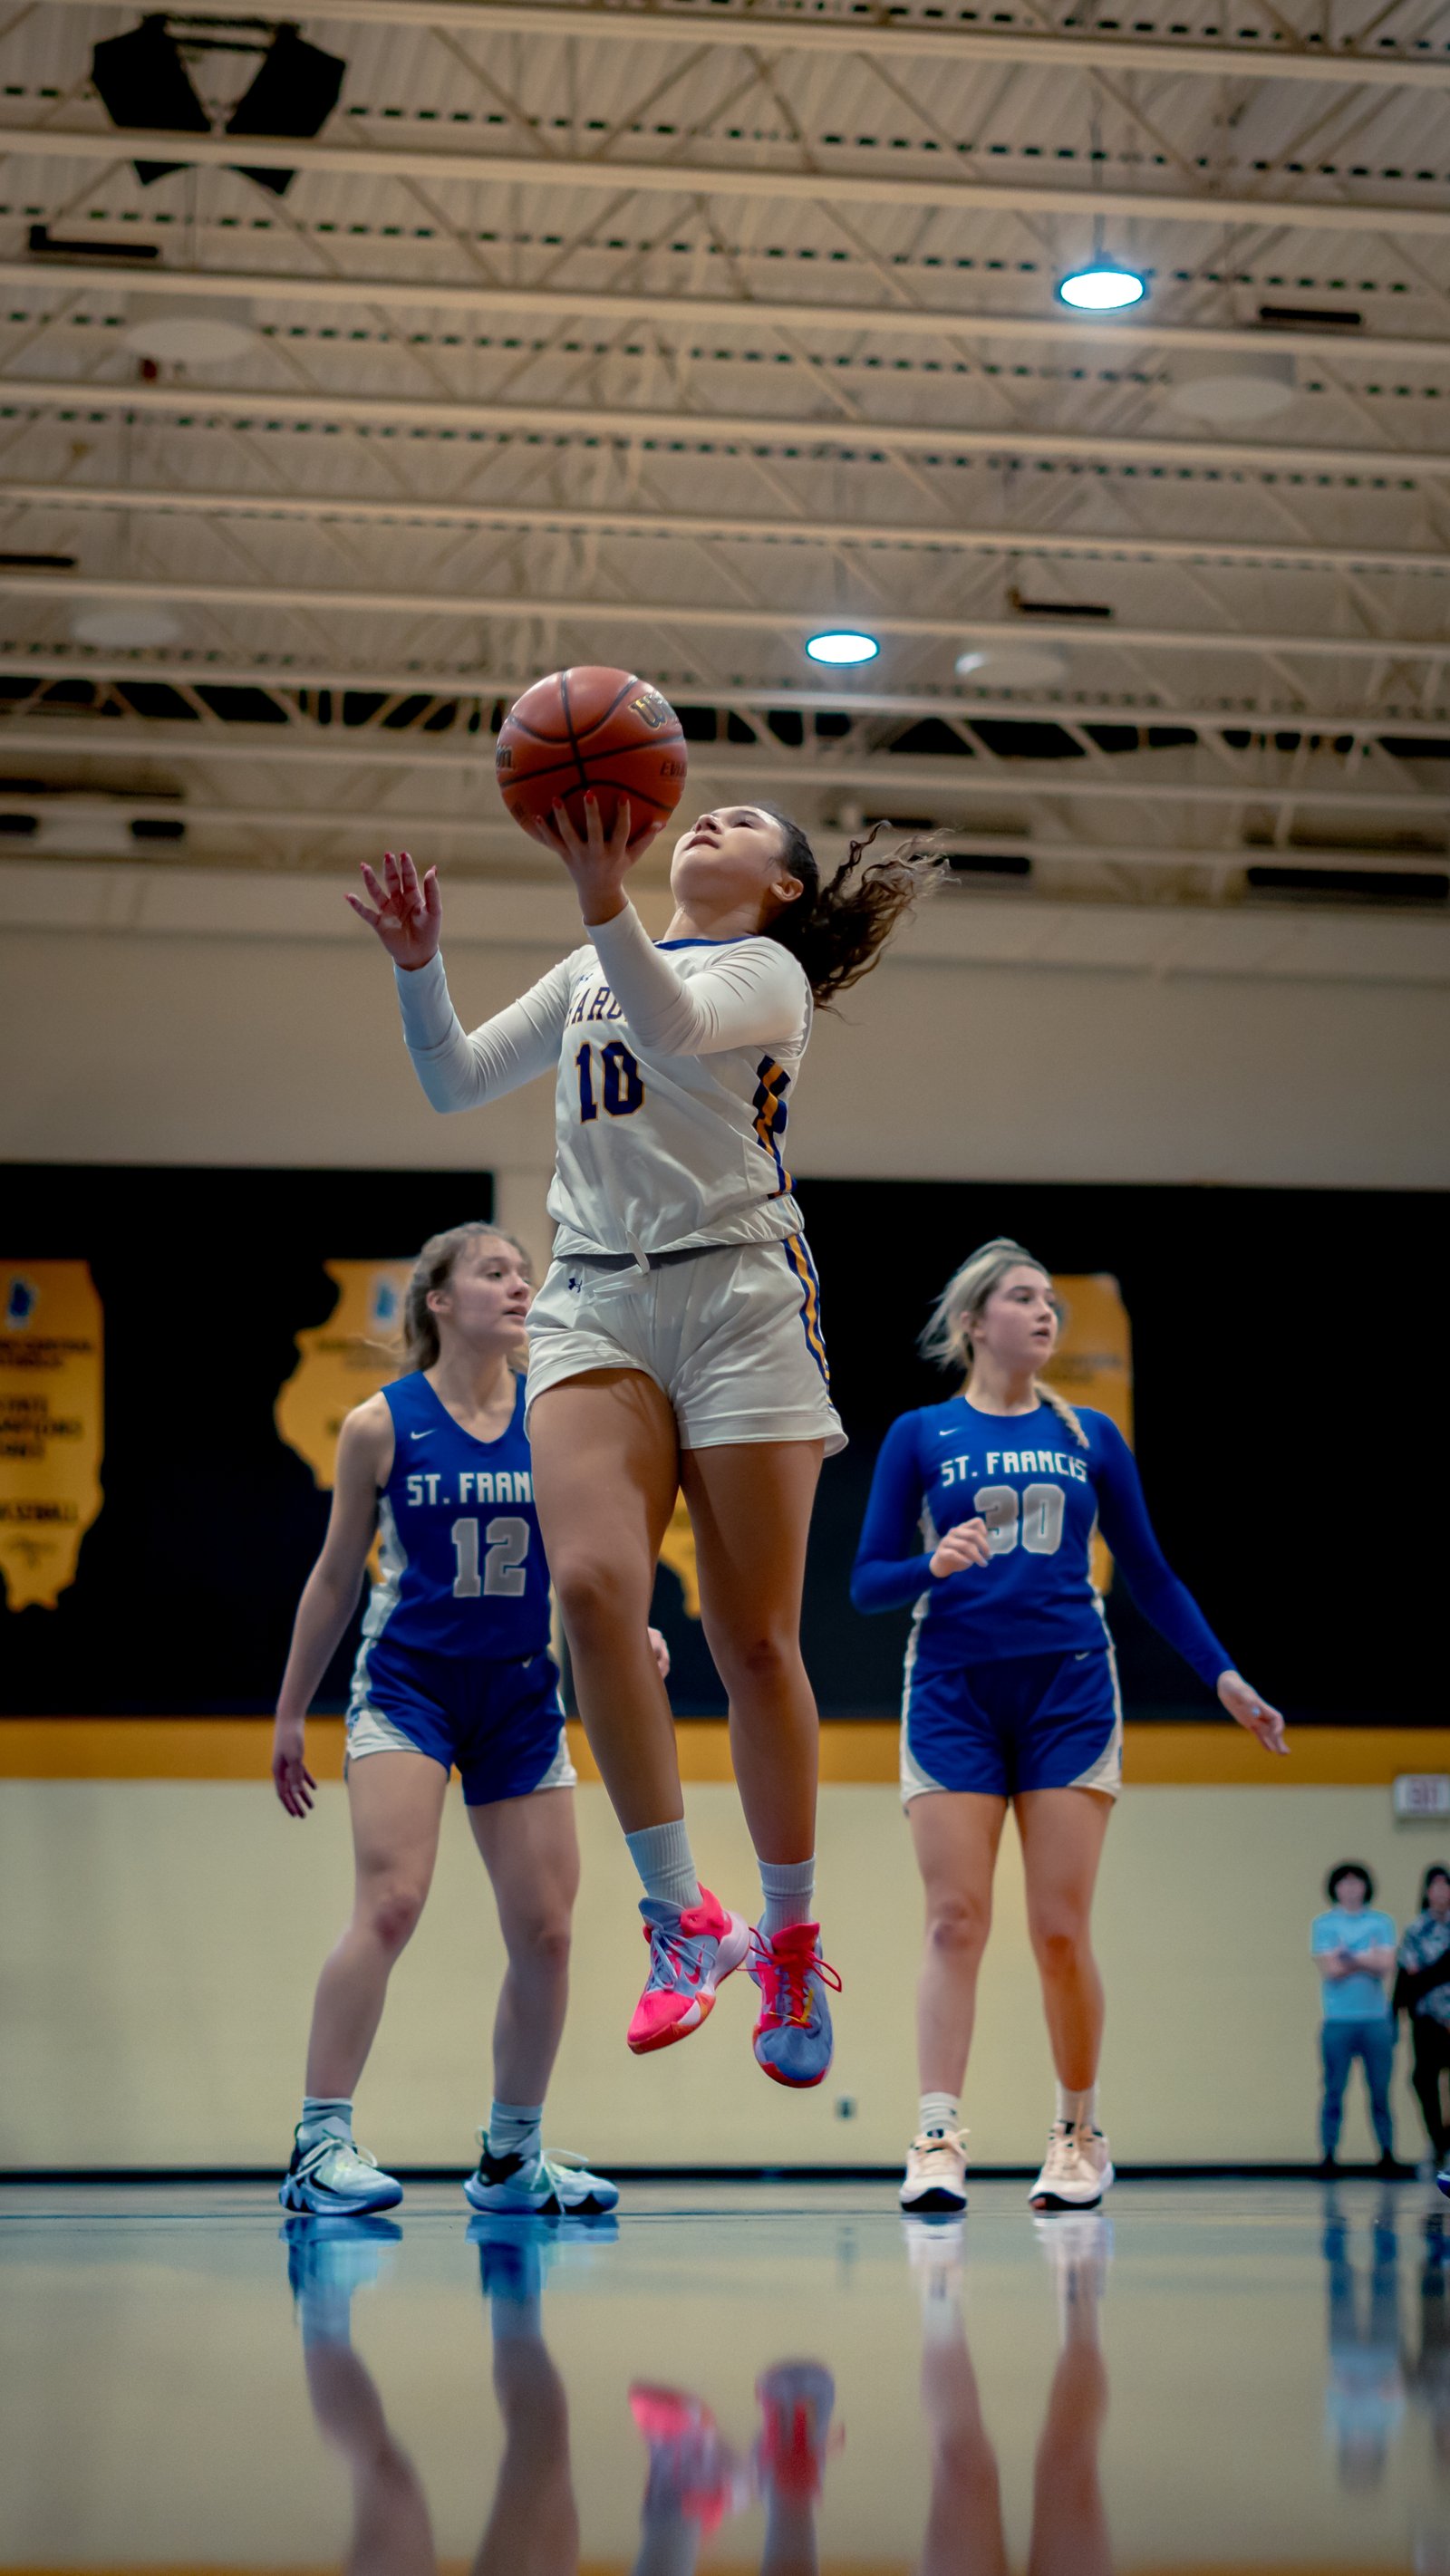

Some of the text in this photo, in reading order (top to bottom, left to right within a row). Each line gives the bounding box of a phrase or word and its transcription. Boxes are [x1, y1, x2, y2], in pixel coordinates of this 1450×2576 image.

[567, 987, 628, 1026] ARD
[575, 1040, 645, 1124] 10
[407, 1472, 533, 1506] ST. FRAN
[941, 1451, 1088, 1487] ST. FRANCIS
[973, 1483, 1065, 1556] 30
[451, 1517, 530, 1597] 12
